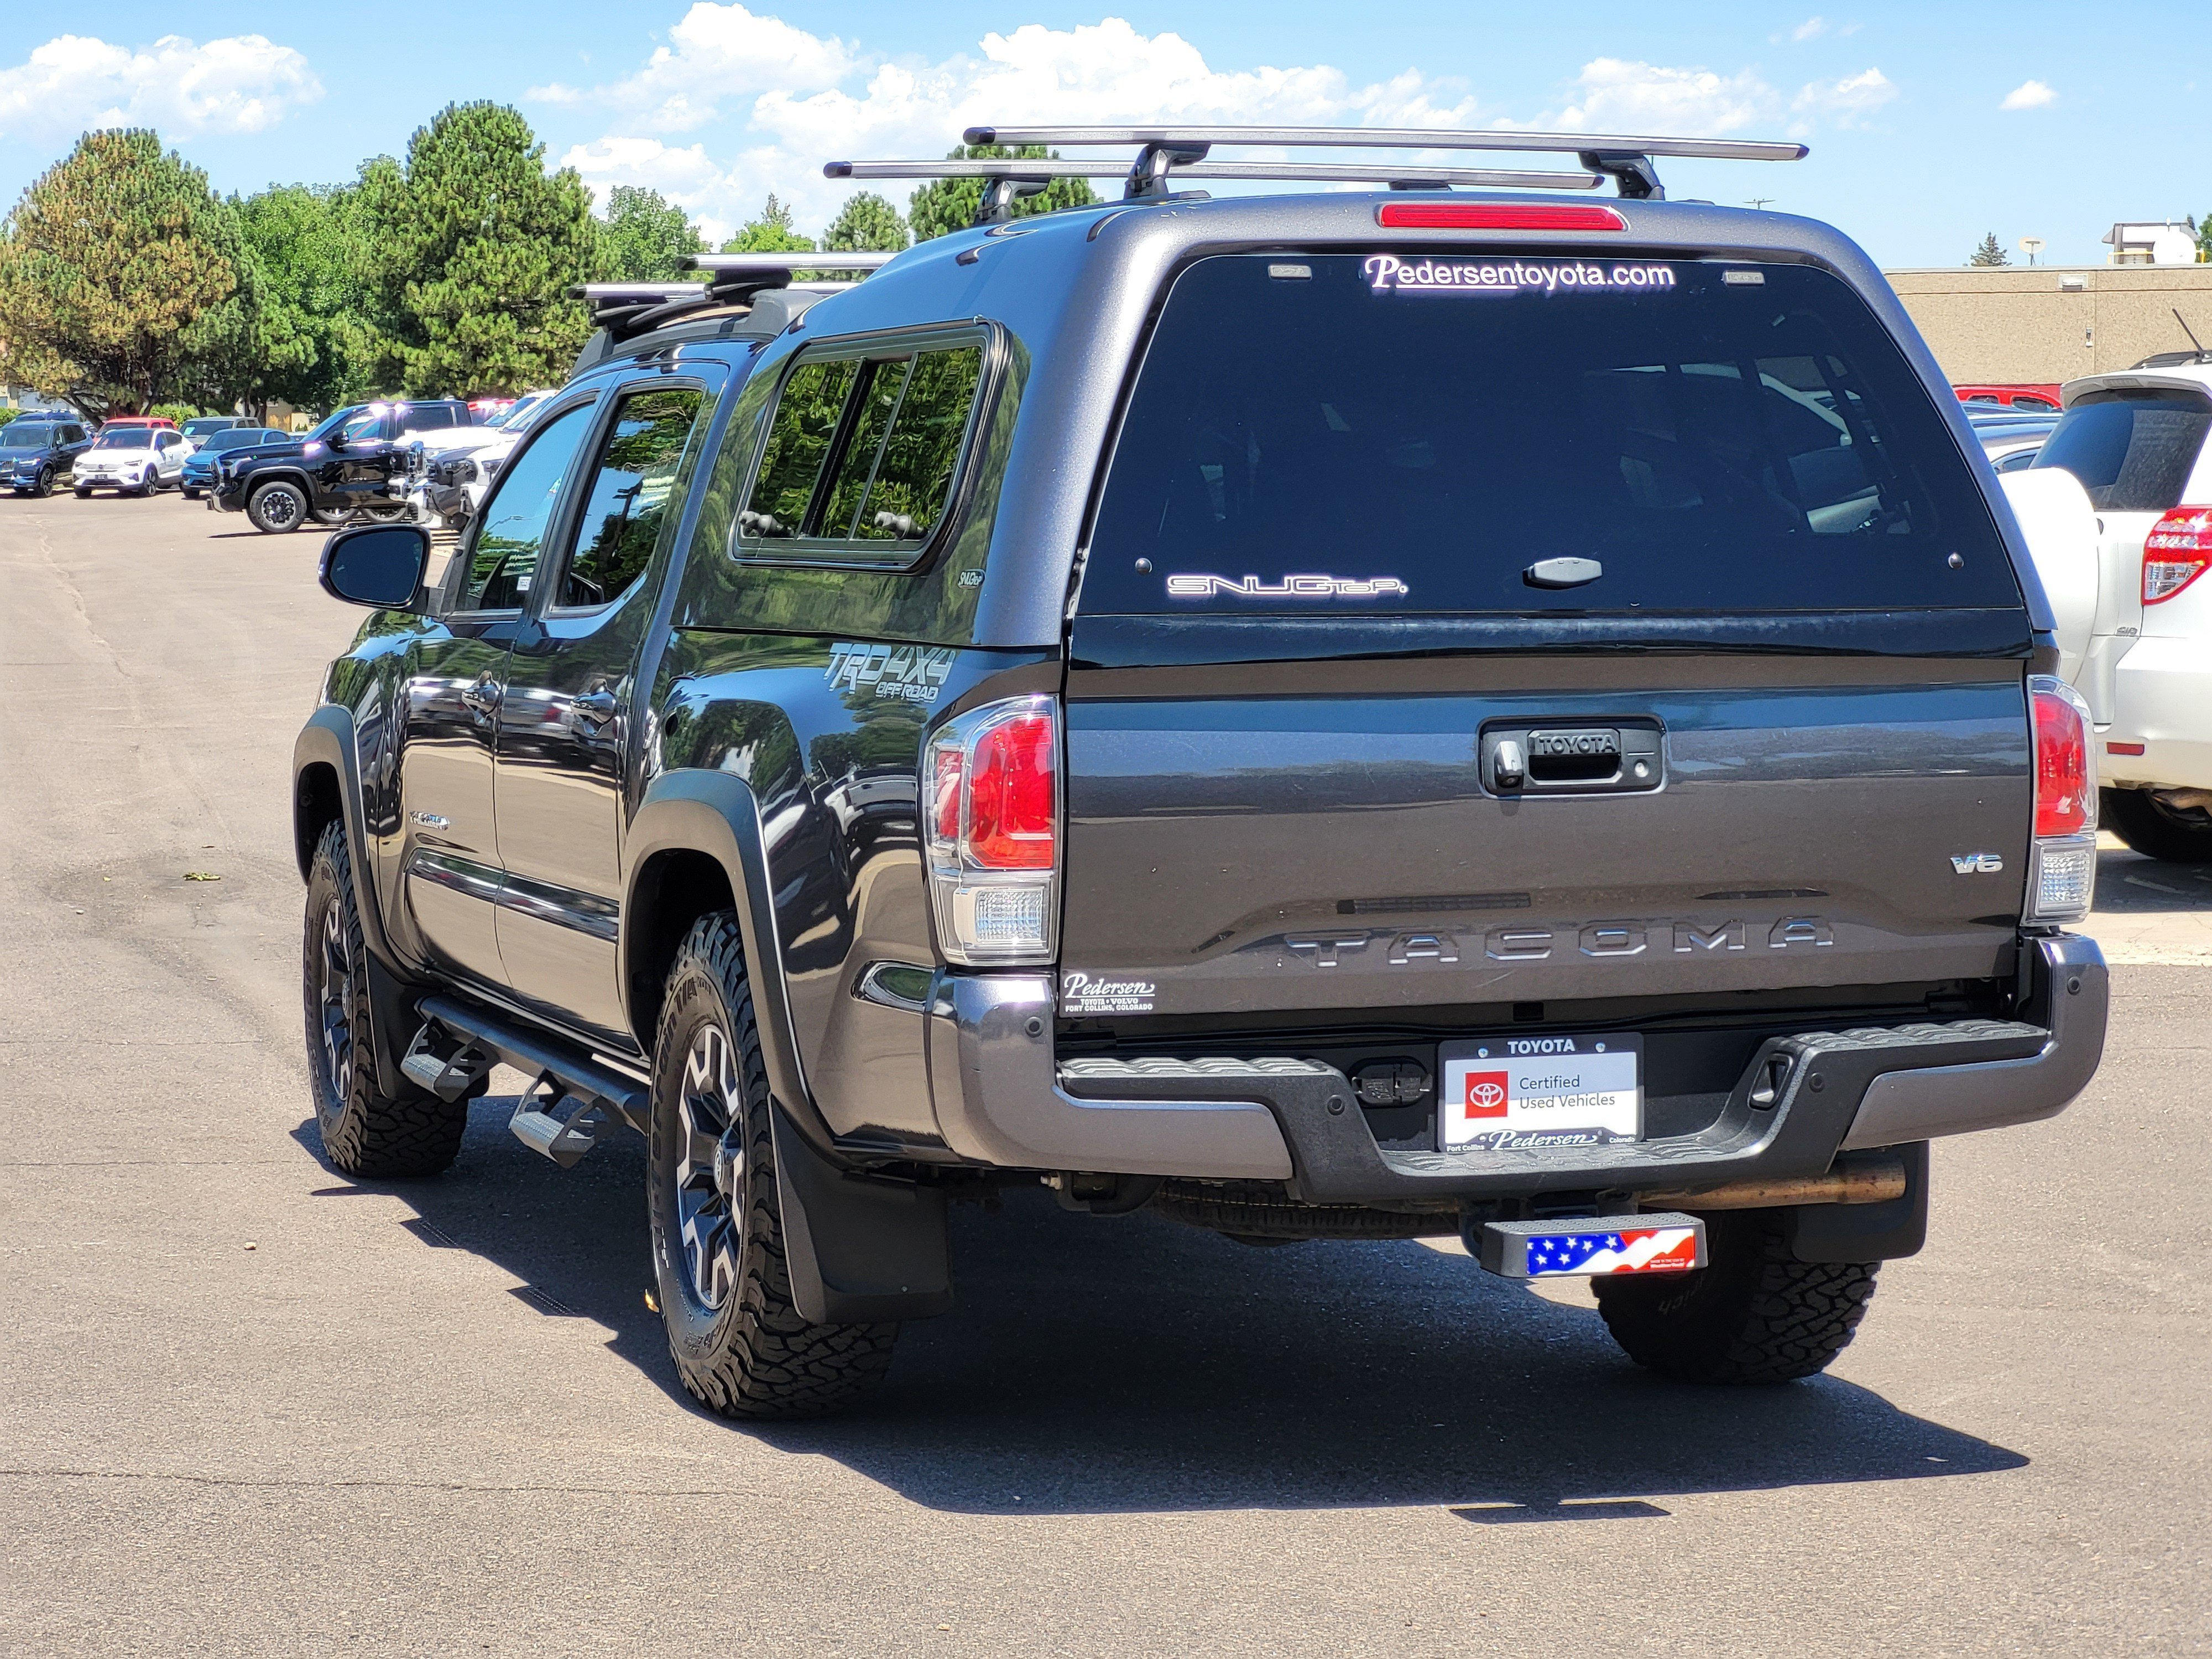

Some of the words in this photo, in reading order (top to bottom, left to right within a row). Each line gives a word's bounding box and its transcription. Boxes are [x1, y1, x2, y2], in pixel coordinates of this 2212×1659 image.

[1365, 255, 1674, 289] Pedersentoyota.com
[823, 642, 893, 695] TRD
[884, 645, 958, 685] 4X4
[1538, 734, 1616, 754] TOYOTA
[1950, 853, 2003, 875] V6
[1284, 915, 1835, 968] TACOMA
[1064, 973, 1156, 998] Pedersen
[1507, 1039, 1575, 1055] TOYOTA
[1520, 1074, 1580, 1089] Certified
[1520, 1095, 1554, 1109] Used
[1558, 1093, 1615, 1107] Vehicles
[1488, 1129, 1598, 1151] Pedersen
